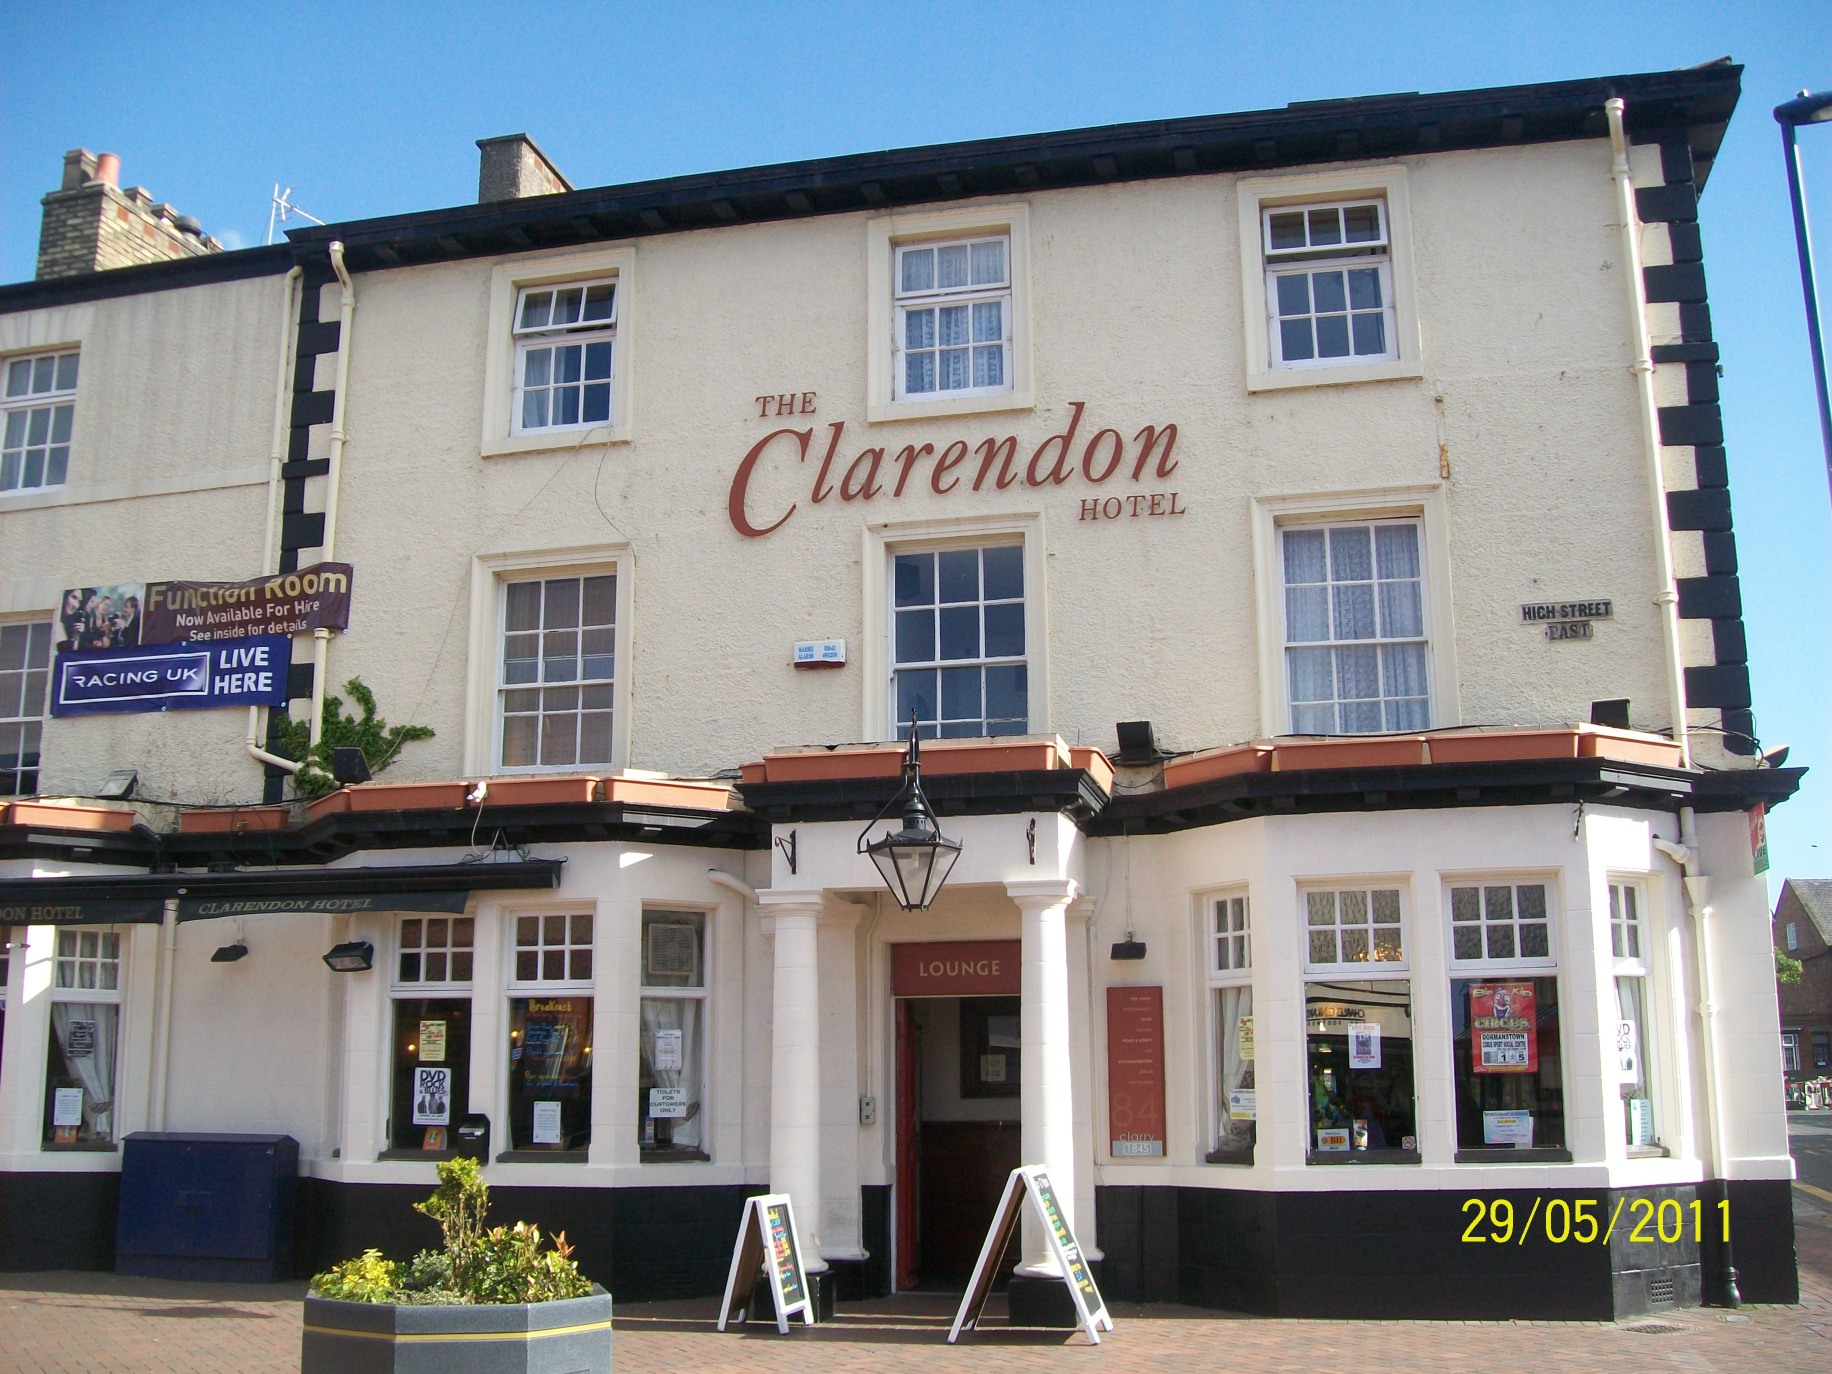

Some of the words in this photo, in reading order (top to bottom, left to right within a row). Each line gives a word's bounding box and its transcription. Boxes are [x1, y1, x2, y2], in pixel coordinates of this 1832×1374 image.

[755, 391, 818, 418] THE
[727, 401, 1179, 538] Clarendon
[1078, 492, 1187, 522] HOTEL
[148, 585, 256, 612] Function
[264, 572, 347, 600] Room
[176, 613, 204, 627] Now
[206, 606, 263, 625] Available
[266, 603, 291, 618] For
[294, 599, 320, 614] Hire
[1522, 605, 1556, 621] HIGH
[1560, 601, 1611, 618] STREET
[189, 629, 211, 642] See
[213, 625, 245, 639] inside
[247, 623, 266, 636] for
[267, 619, 307, 634] details
[1547, 623, 1590, 640] EAST
[219, 646, 270, 670] LIVE
[72, 670, 159, 688] RACING
[166, 668, 199, 681] UK
[213, 672, 273, 696] HERE
[30, 906, 84, 920] HOTEL
[199, 899, 311, 916] CLARENDON
[313, 898, 373, 911] HOTEL
[919, 960, 1001, 977] LOUNGE
[1474, 1016, 1529, 1029] CIRCUS
[1500, 1053, 1506, 1061] 1
[1518, 1053, 1525, 1061] 5
[420, 1070, 446, 1082] DVD
[419, 1080, 445, 1090] ROCK
[424, 1087, 446, 1095] BLUES
[1119, 1131, 1155, 1142] clarry
[1127, 1143, 1150, 1153] 1845
